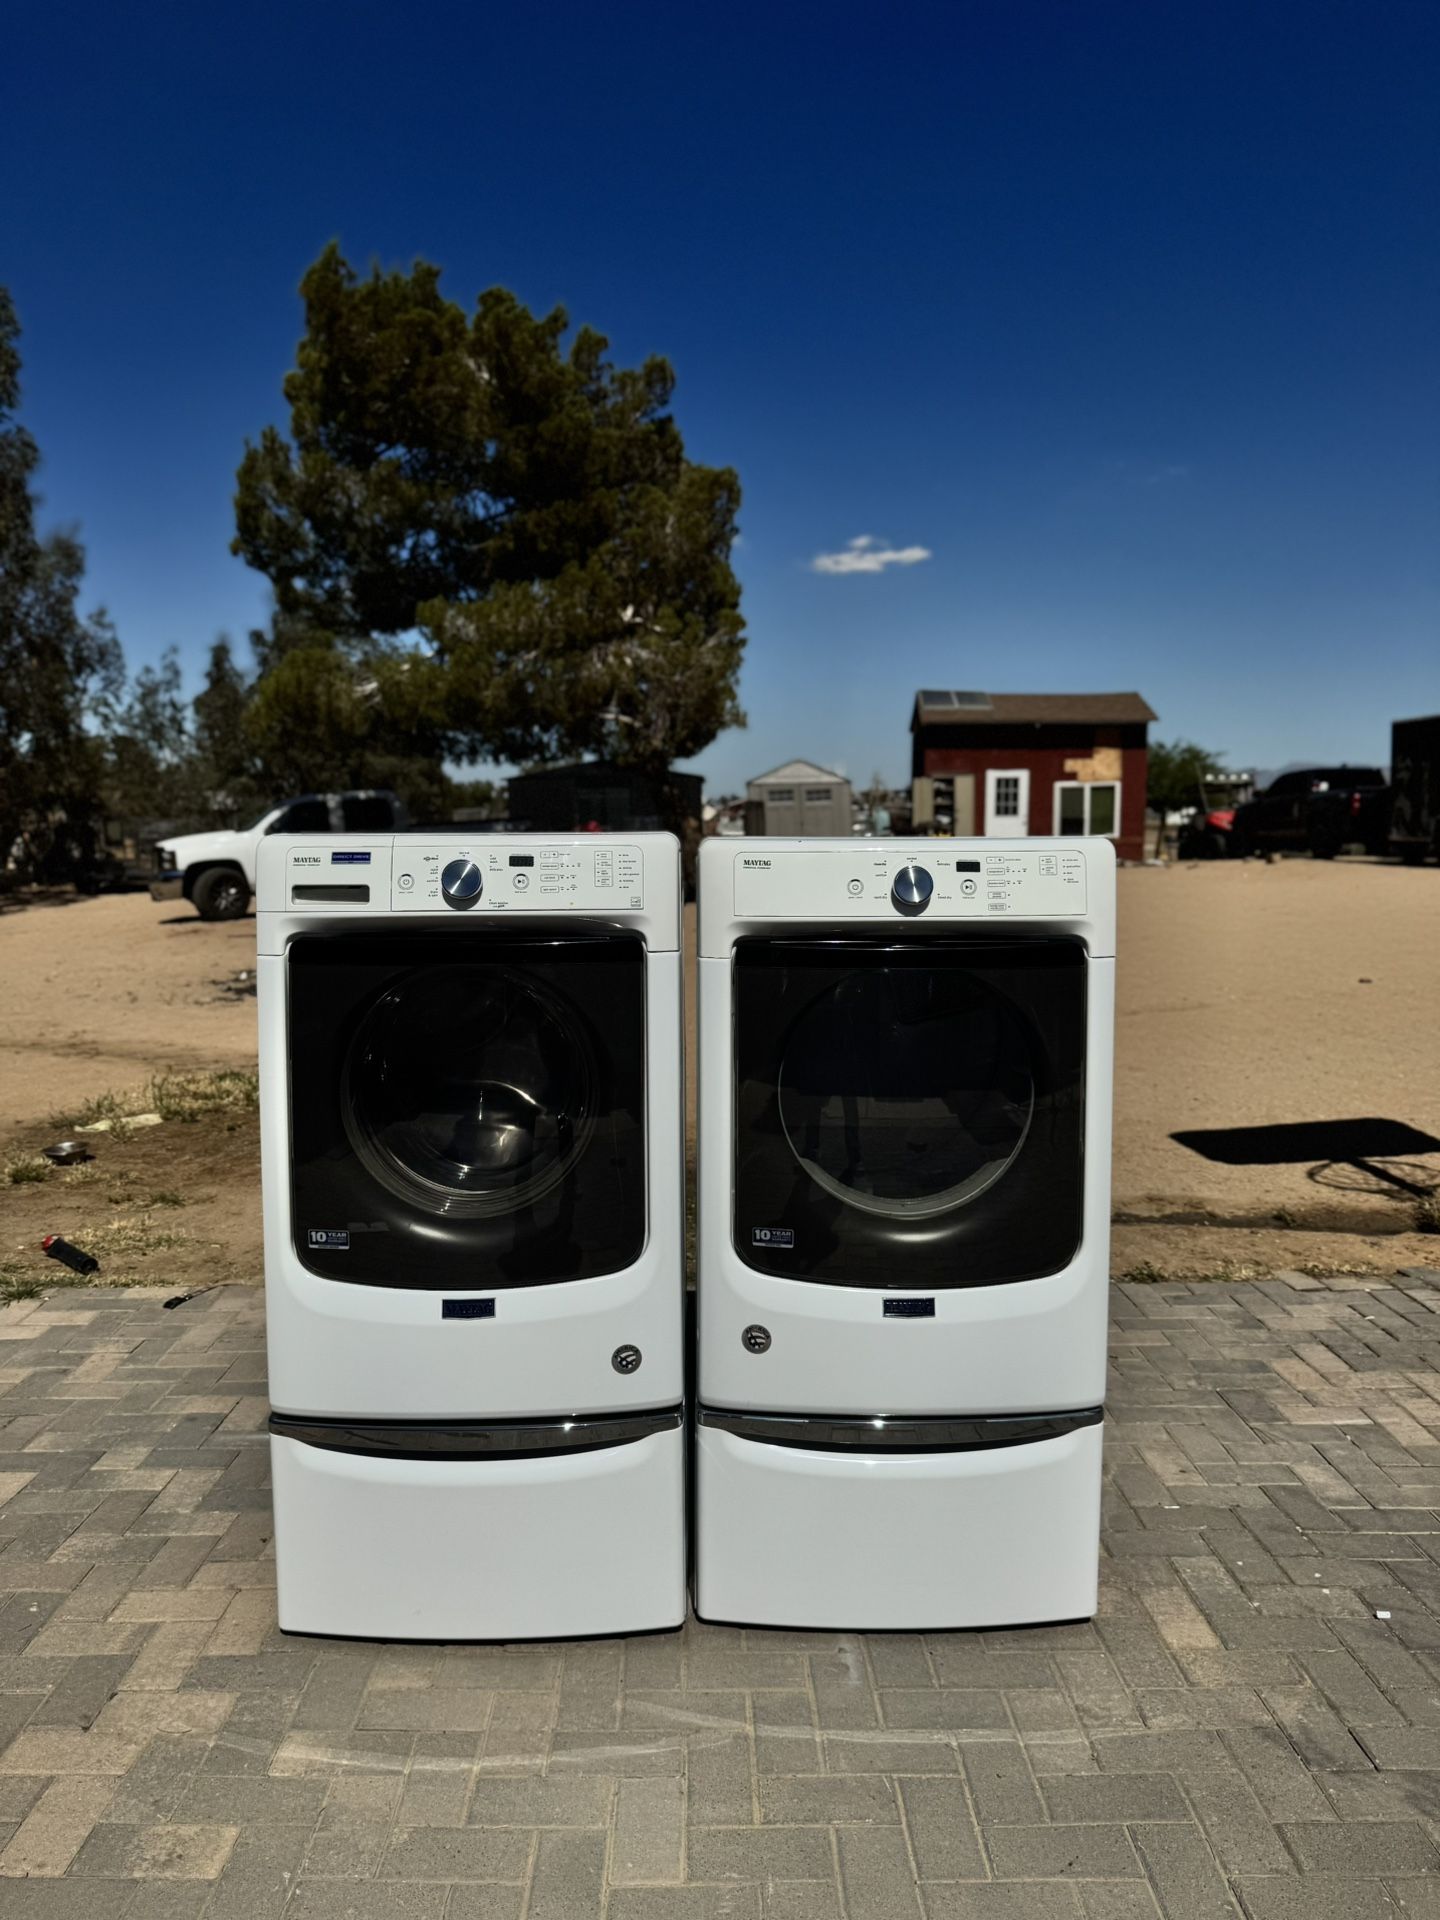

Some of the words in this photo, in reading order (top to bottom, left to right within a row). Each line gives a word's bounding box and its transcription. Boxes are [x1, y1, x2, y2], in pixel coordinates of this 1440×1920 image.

[293, 856, 321, 864] MAYTAG
[310, 1231, 327, 1242] 10
[754, 1229, 771, 1241] 10
